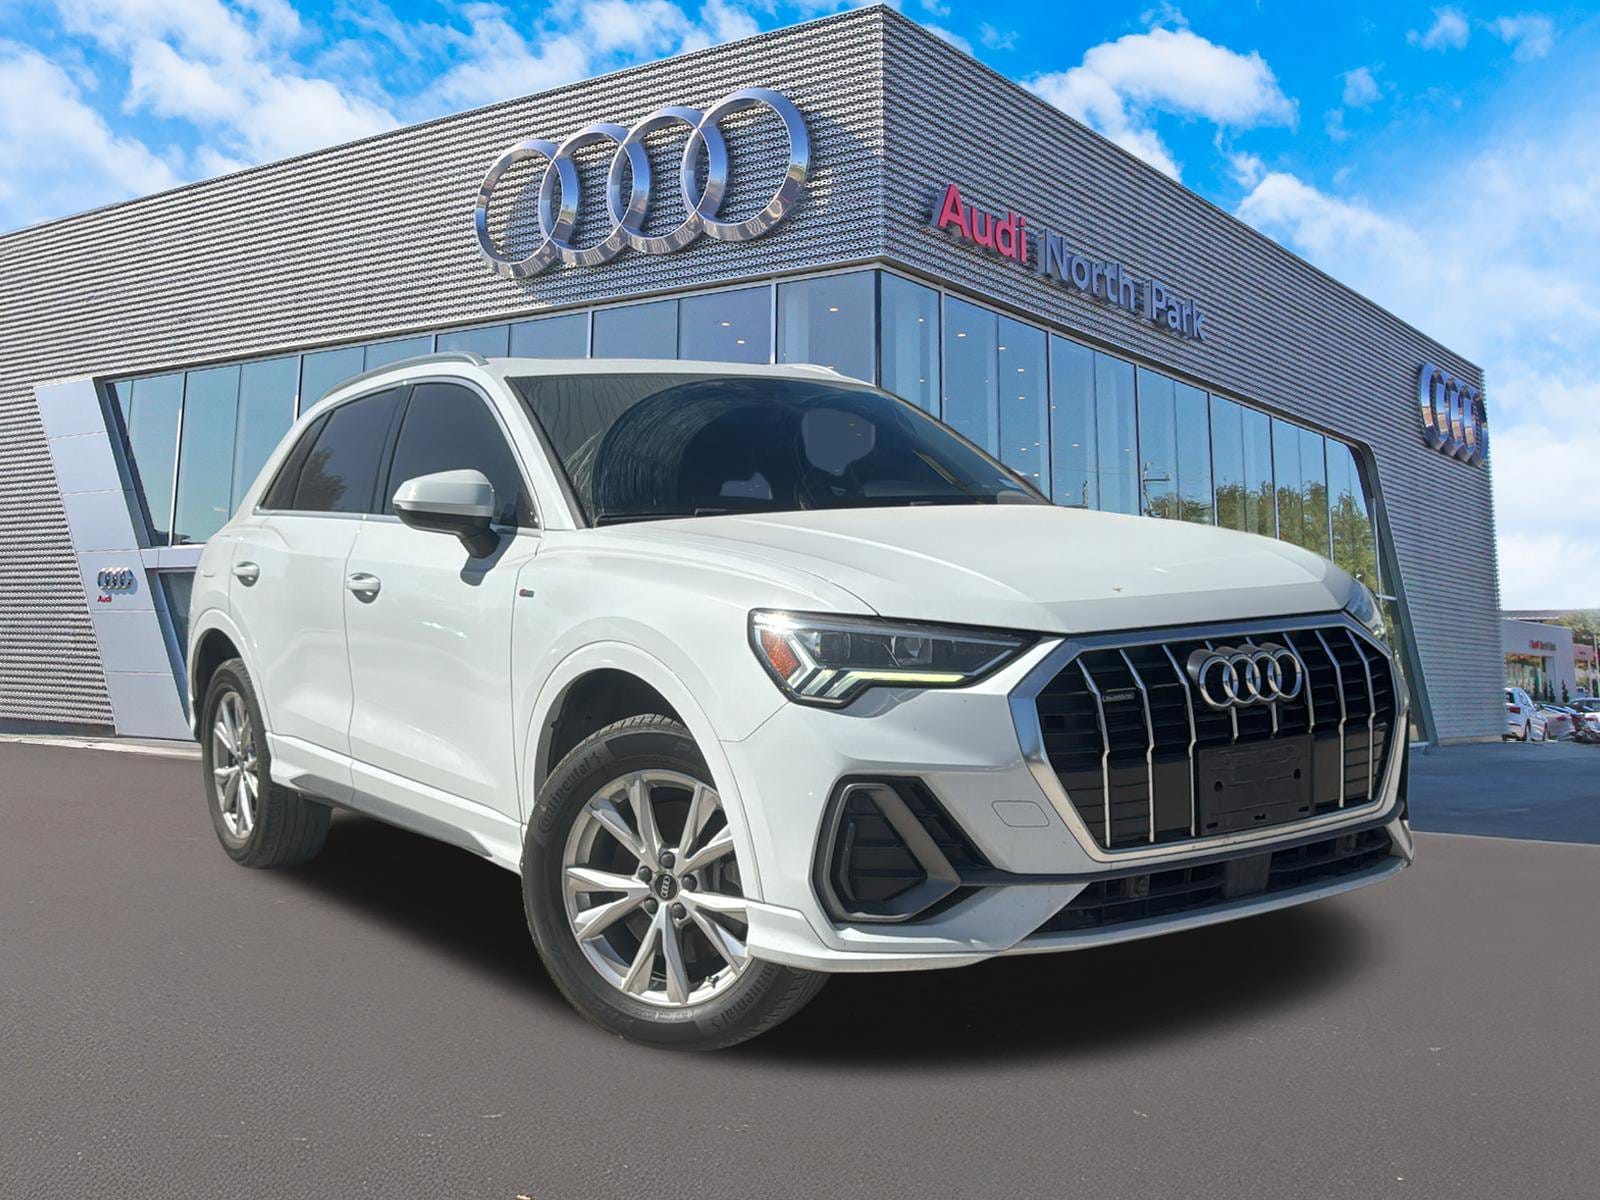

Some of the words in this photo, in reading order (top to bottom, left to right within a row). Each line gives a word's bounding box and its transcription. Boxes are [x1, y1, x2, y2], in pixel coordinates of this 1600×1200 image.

[935, 183, 1028, 263] Audi
[1042, 229, 1136, 310] North
[1147, 278, 1207, 341] Park
